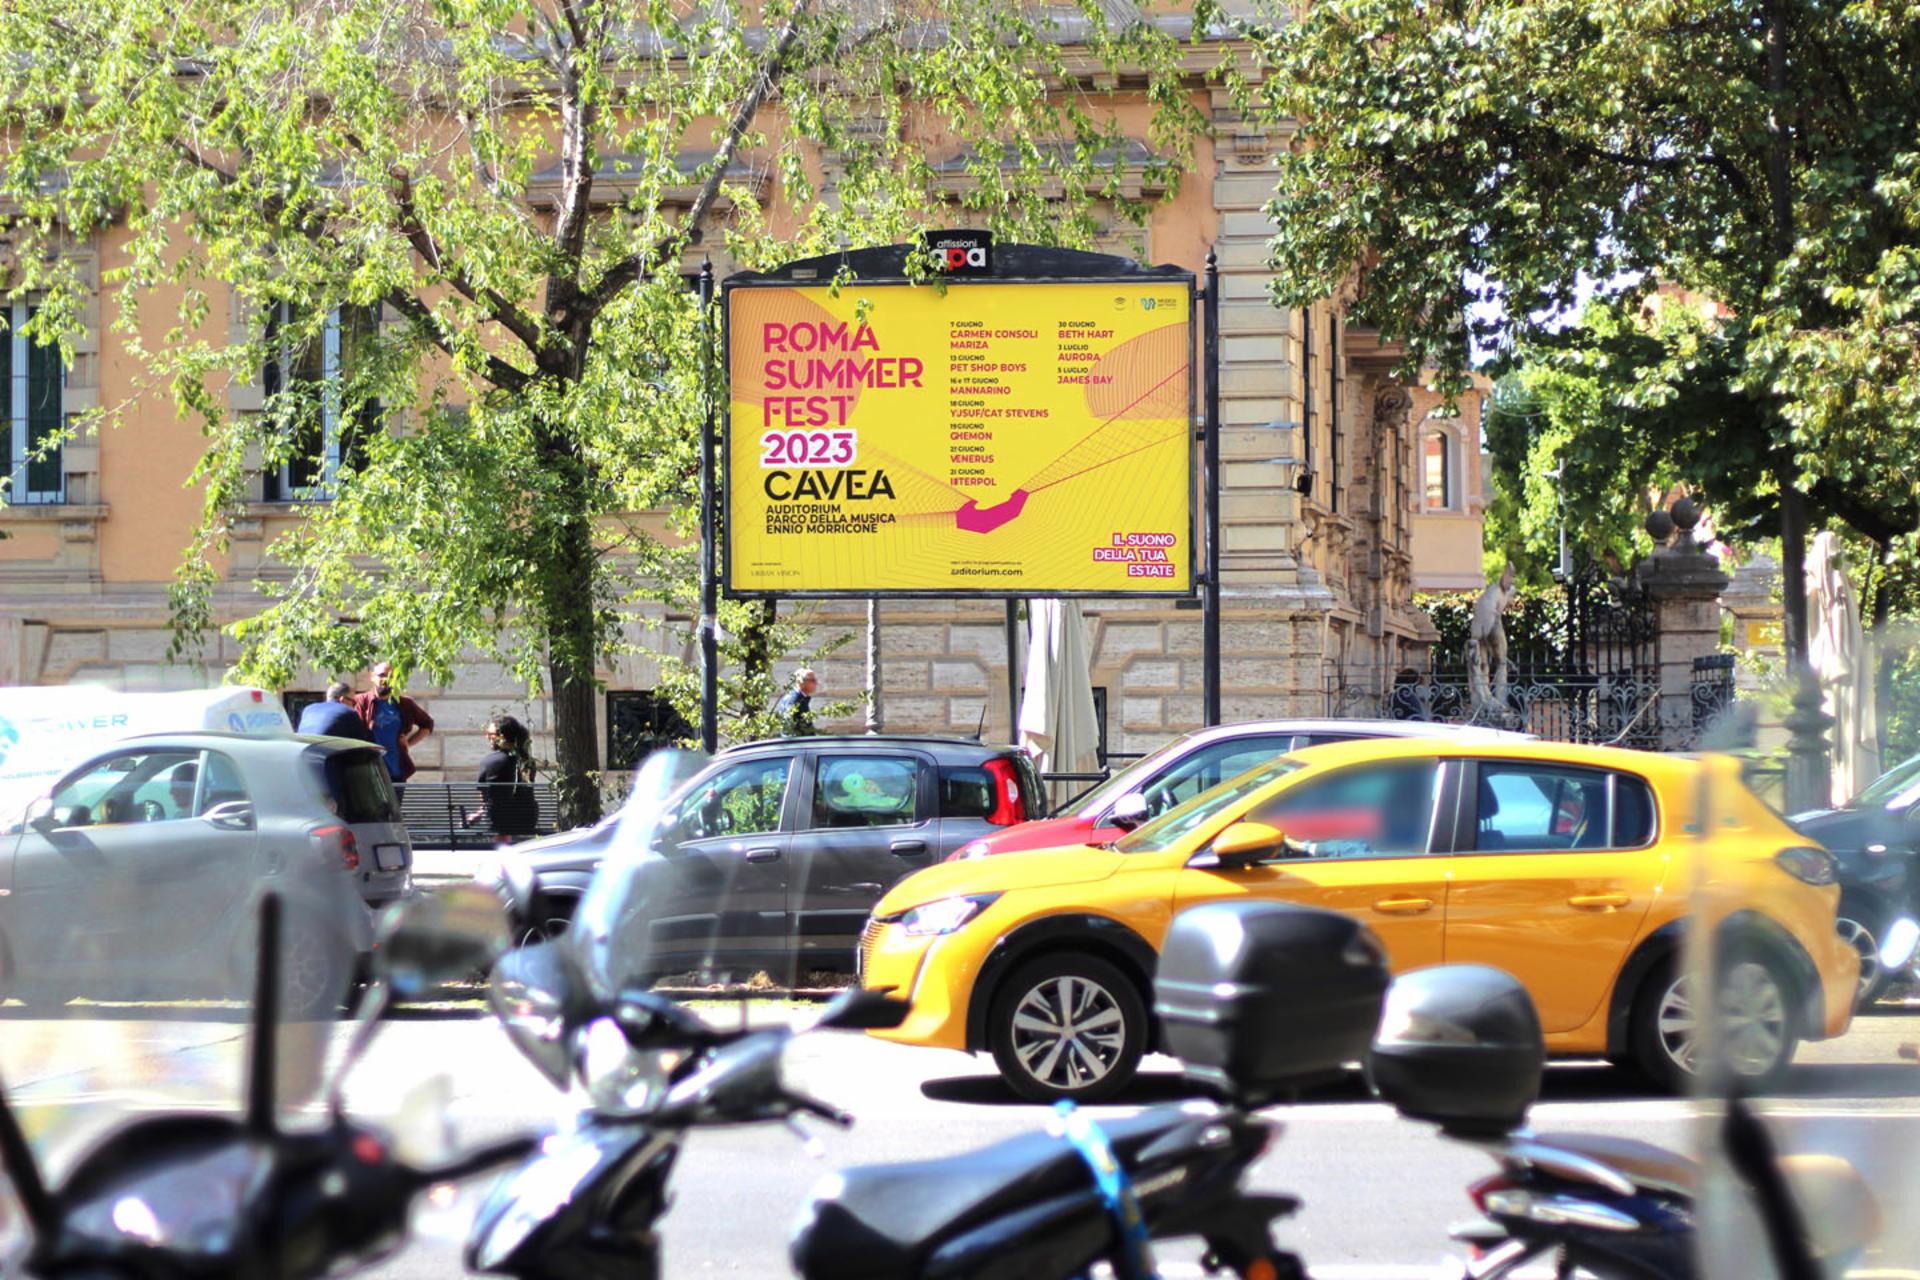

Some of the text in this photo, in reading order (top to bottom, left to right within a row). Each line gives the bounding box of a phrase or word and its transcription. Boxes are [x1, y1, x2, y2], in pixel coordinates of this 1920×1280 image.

[937, 239, 977, 248] affissioni
[930, 248, 986, 271] apa
[763, 321, 880, 352] ROMA
[950, 330, 1038, 339] CARMEN CONSOLI
[1058, 330, 1114, 338] BETH HART
[950, 341, 989, 349] MARIZA
[1058, 353, 1101, 361] AURORA
[950, 363, 1027, 372] PET SHOP BOYS
[764, 357, 924, 390] SUMMER
[1057, 375, 1113, 384] JAMES BAY
[950, 386, 1011, 395] MANNARINO
[763, 395, 855, 427] FEST
[1005, 408, 1049, 418] STEVENS
[764, 433, 853, 464] 2023
[950, 454, 994, 463] VENERUS
[764, 469, 897, 501] CAVEA
[766, 504, 841, 514] AUDITORIUM
[766, 513, 896, 524] PARCO DELLA MUSICA
[766, 523, 878, 534] ENNIO MORRICONE
[1113, 534, 1175, 546] IL SUONO
[1094, 549, 1166, 560] DELLA TUA
[1128, 564, 1174, 576] ESTATE
